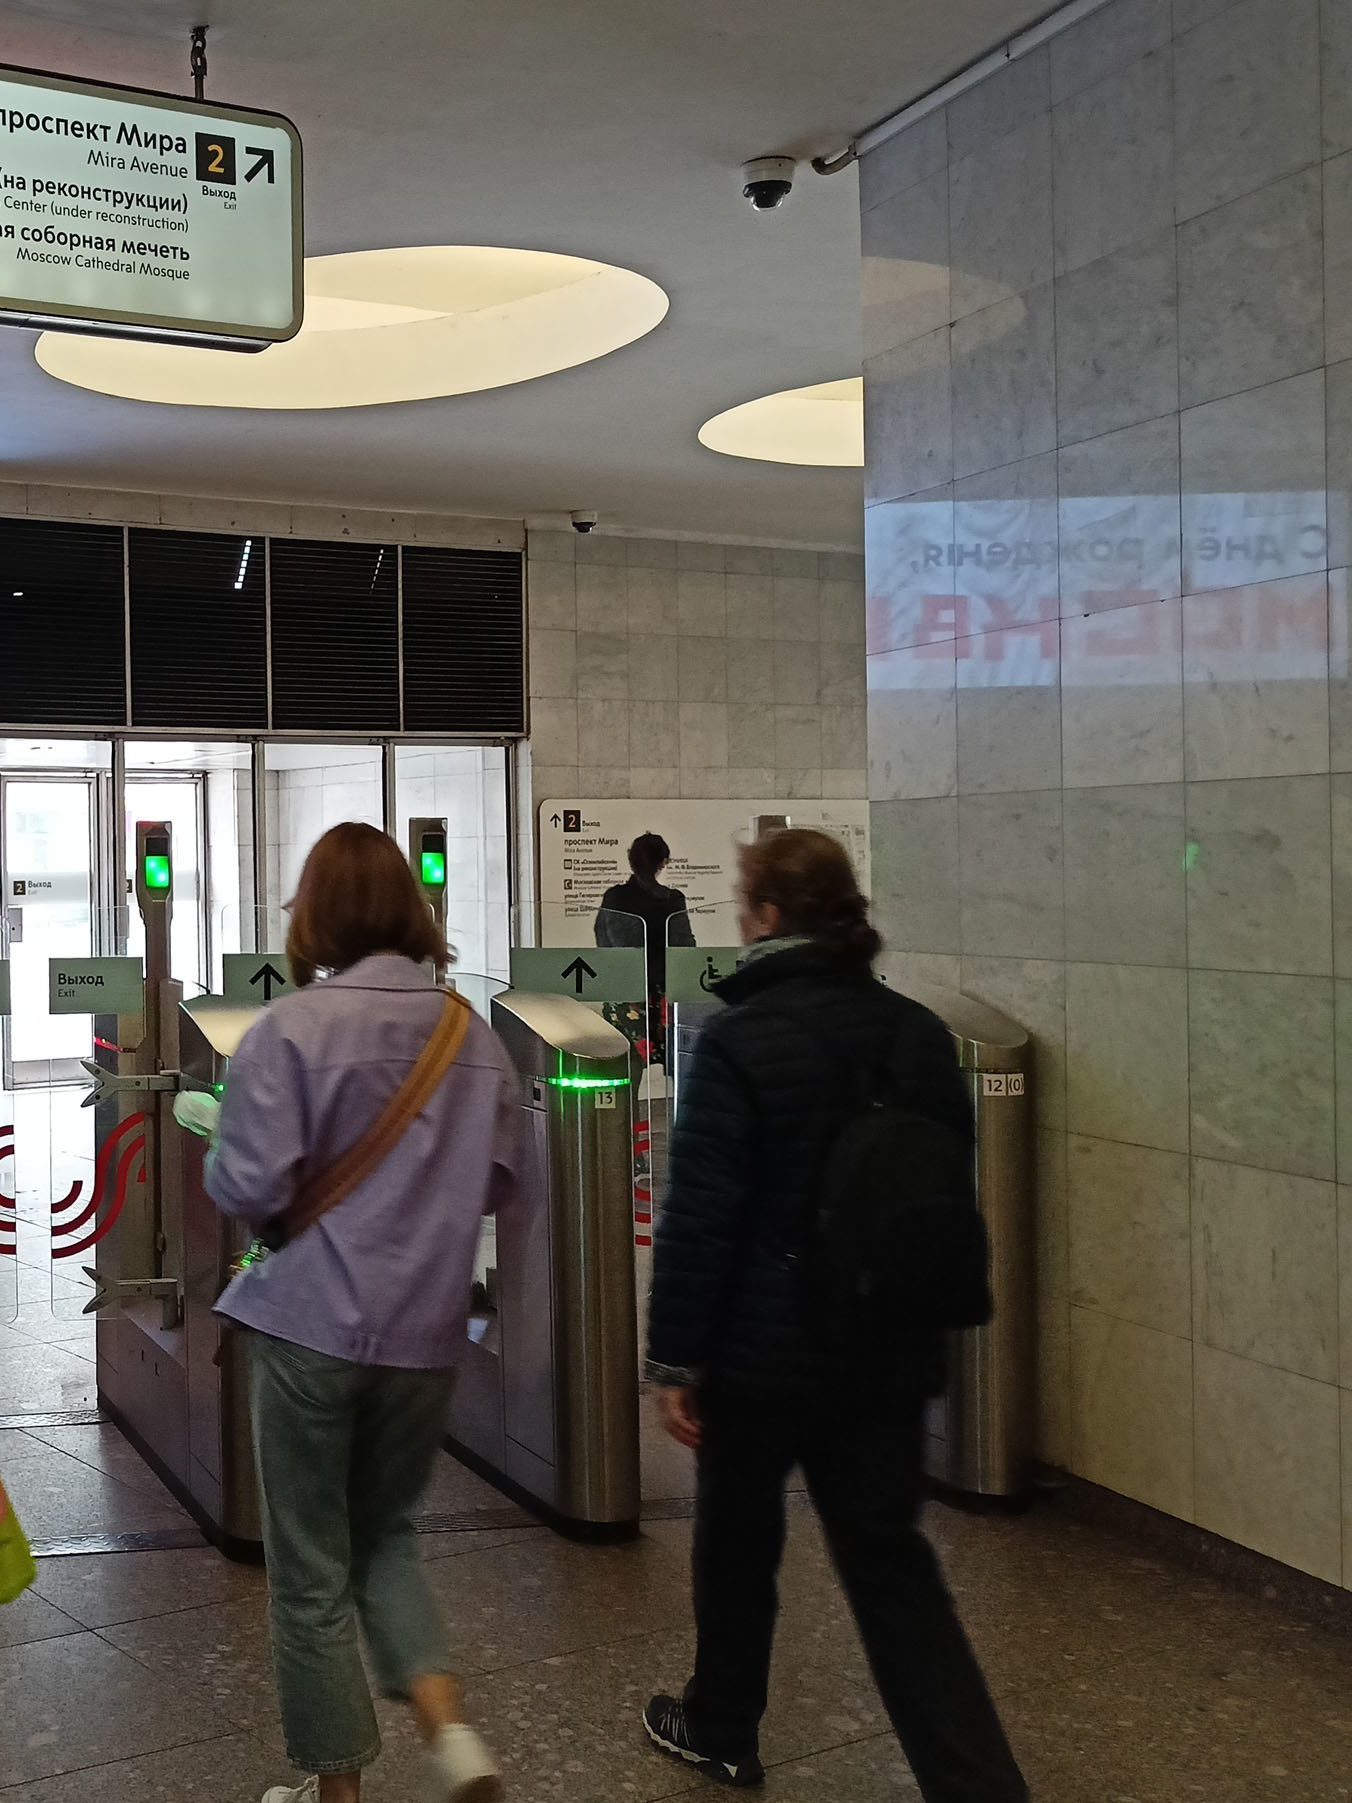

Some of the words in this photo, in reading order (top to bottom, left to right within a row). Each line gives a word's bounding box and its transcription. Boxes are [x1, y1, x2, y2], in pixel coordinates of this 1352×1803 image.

[115, 121, 187, 156] Мира
[87, 149, 126, 170] Mira
[130, 155, 188, 179] Avenue
[207, 144, 225, 174] 2
[32, 177, 188, 214] реконструкции)
[201, 185, 237, 201] Выход
[223, 201, 237, 211] Exit
[4, 195, 47, 213] Center
[50, 201, 92, 220] (under
[96, 208, 189, 233] reconstruction)
[20, 225, 115, 252] соборная
[121, 239, 190, 261] мечеть
[16, 247, 71, 266] Moscow
[75, 254, 136, 274] Cathedral
[139, 262, 190, 281] Mosque
[568, 814, 576, 828] 2
[564, 838, 597, 847] проспект
[598, 837, 619, 847] Мира
[16, 883, 23, 893] 2
[28, 880, 52, 888] Выход
[57, 972, 105, 986] Выход
[57, 988, 76, 998] Exit
[986, 1079, 1003, 1093] 12
[598, 1091, 613, 1105] 13
